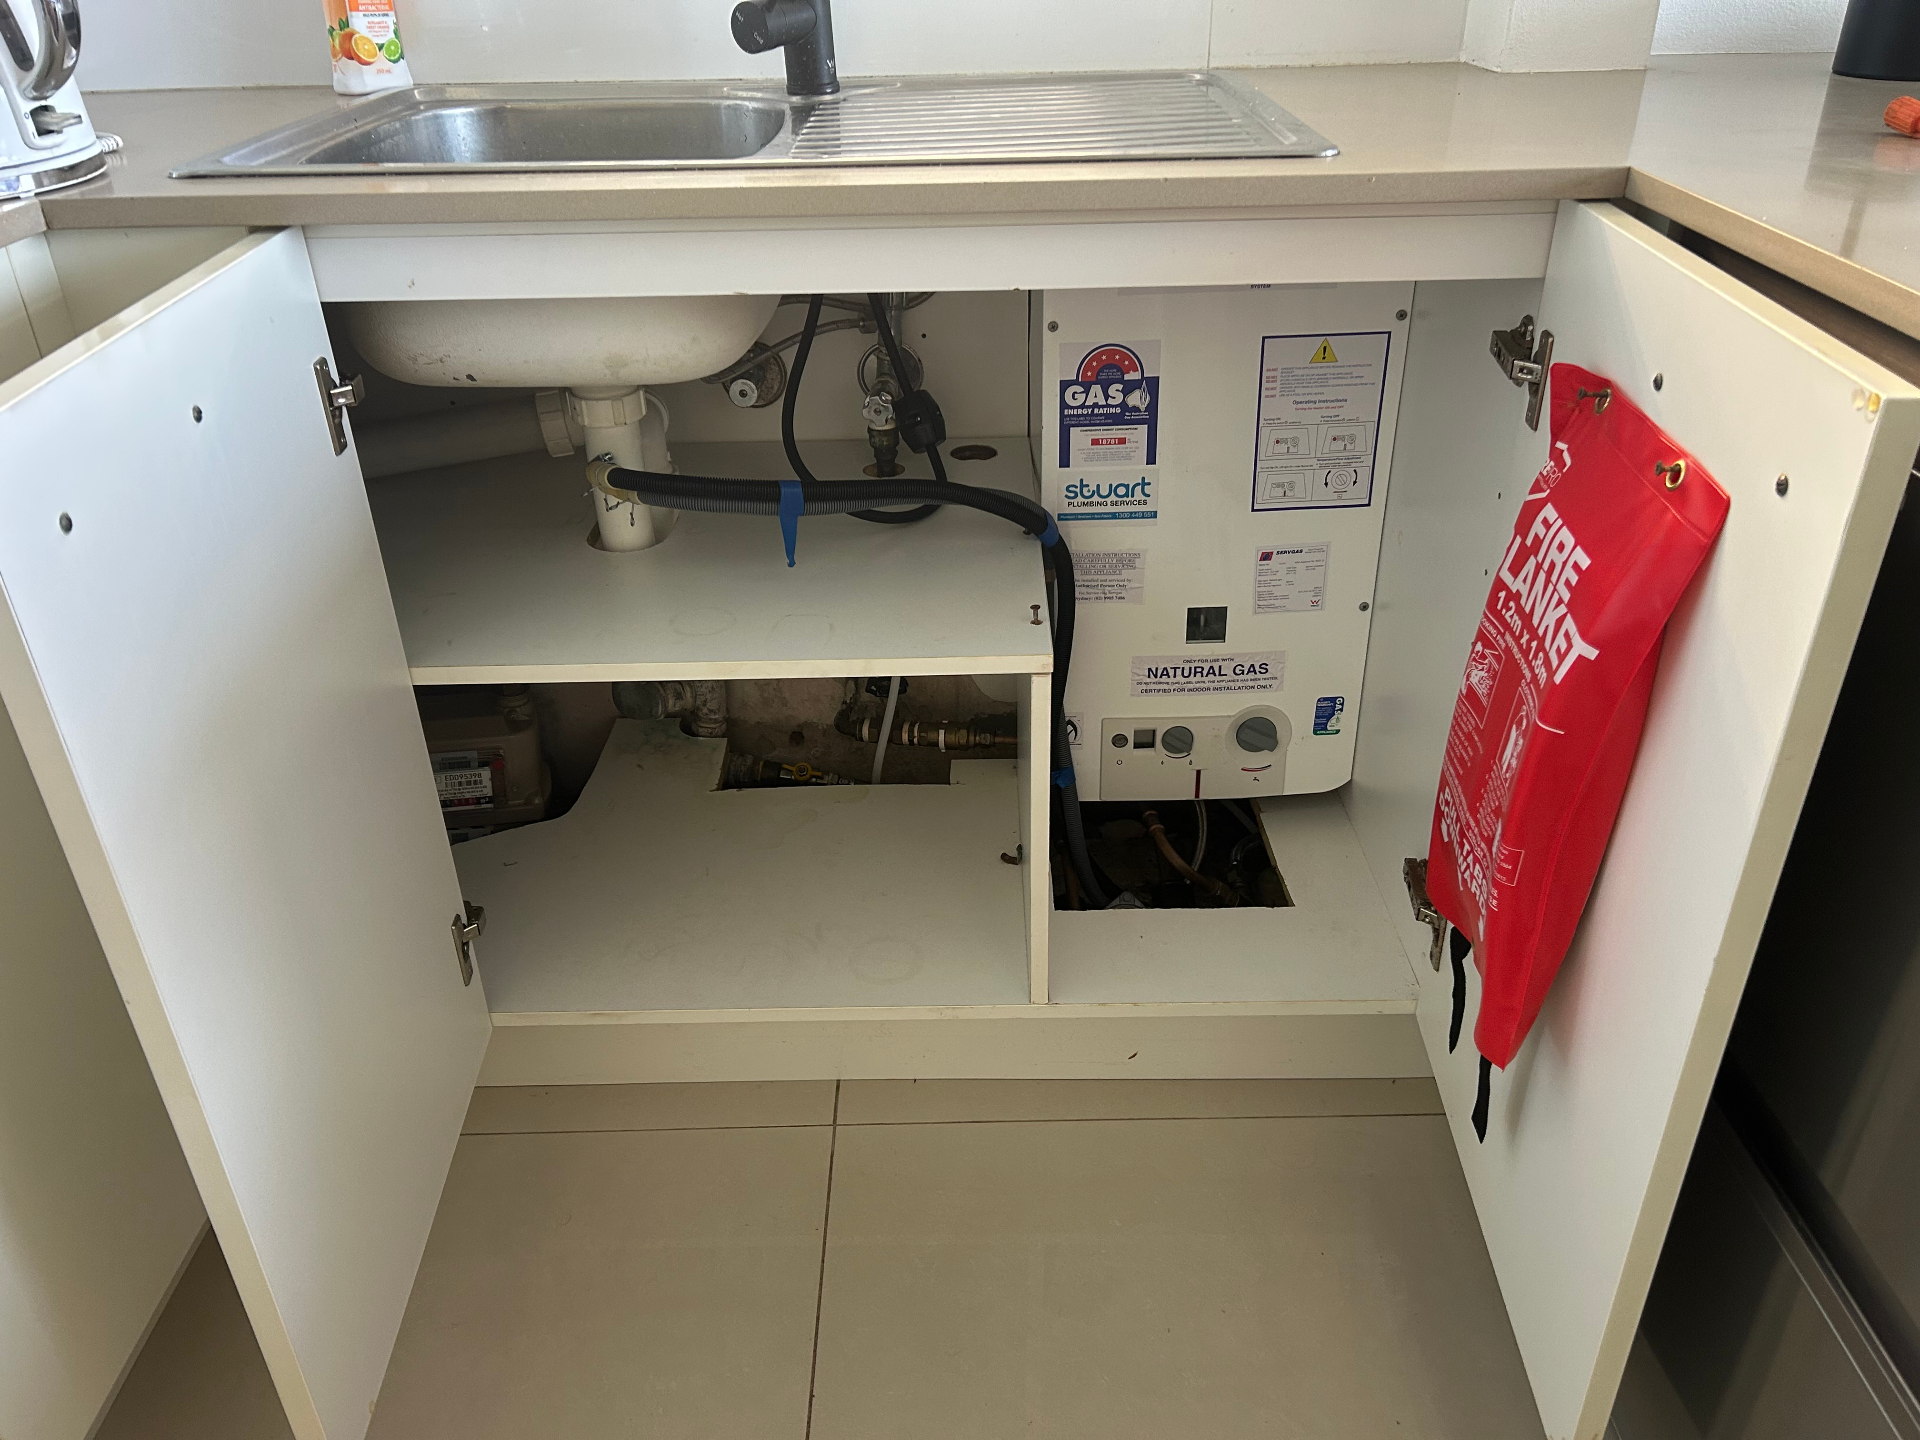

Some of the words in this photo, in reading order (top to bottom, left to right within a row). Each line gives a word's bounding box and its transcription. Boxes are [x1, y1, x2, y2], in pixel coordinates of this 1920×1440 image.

[1064, 383, 1123, 406] GAS
[1064, 476, 1151, 500] stuart
[1525, 502, 1591, 605] FIRE
[1497, 590, 1522, 636] 1.2m
[1520, 629, 1530, 649] x
[1529, 640, 1547, 689] 1.8m
[1499, 535, 1600, 685] LANKET
[1147, 665, 1227, 678] NATURAL
[1232, 663, 1269, 676] GAS
[1504, 631, 1531, 682] INSTRUCTIONS
[1444, 785, 1460, 843] PULL
[1462, 838, 1487, 899] TABS
